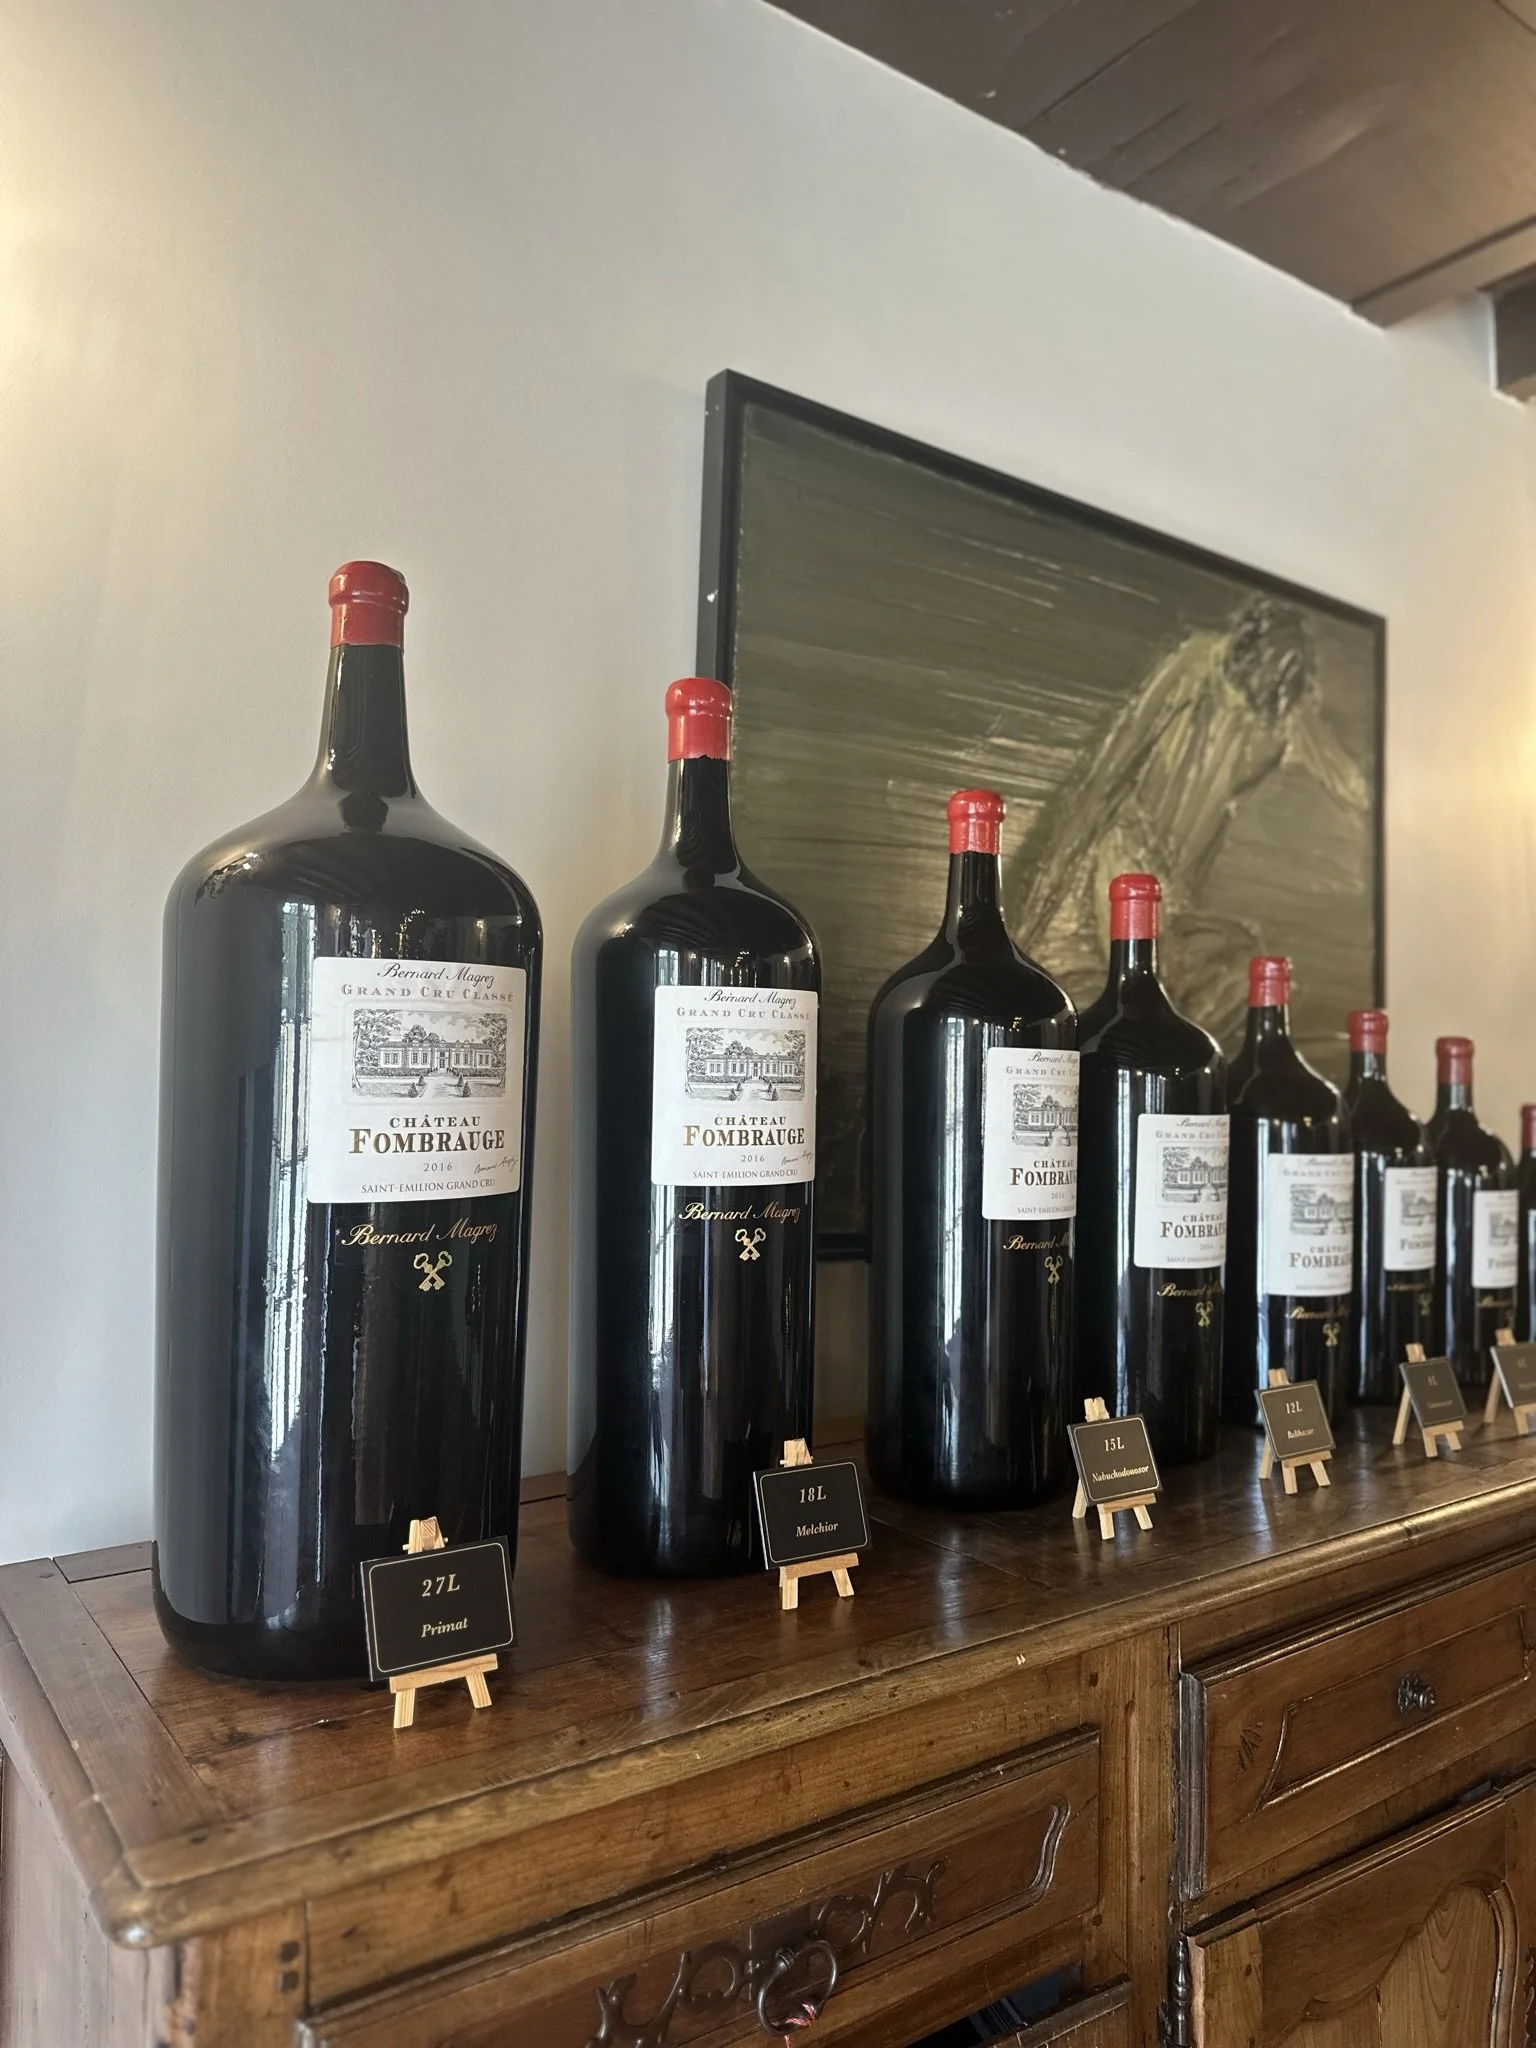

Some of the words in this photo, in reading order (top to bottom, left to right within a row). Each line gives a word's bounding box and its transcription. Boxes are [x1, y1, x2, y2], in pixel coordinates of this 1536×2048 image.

[377, 962, 446, 979] Bernard
[446, 966, 496, 988] Magrez
[342, 983, 412, 998] GRAND
[420, 986, 456, 999] CRU
[704, 989, 758, 1003] Bernard
[677, 1007, 732, 1018] GRAND
[738, 1008, 766, 1019] CRU
[1006, 1066, 1047, 1076] GRAND
[389, 1114, 481, 1128] CHÂTEAU
[714, 1114, 787, 1126] CHÂTEAU
[348, 1128, 506, 1154] FOMBRAUGE
[682, 1125, 805, 1147] FOMBRAUGE
[741, 1154, 765, 1163] 2016
[423, 1162, 453, 1172] 2016
[446, 1179, 479, 1190] GRAND
[480, 1178, 496, 1187] CRU
[679, 1202, 752, 1220] Bernard
[753, 1201, 802, 1224] Magrez
[341, 1223, 436, 1246] Bernard
[436, 1217, 498, 1244] Magrez
[1003, 1234, 1056, 1250] Bernard
[1286, 1400, 1303, 1415] 12L
[1105, 1437, 1124, 1451] 15L
[800, 1486, 826, 1503] 18L
[796, 1521, 839, 1538] Melchior
[422, 1574, 460, 1598] 27L
[421, 1617, 469, 1638] Primat
